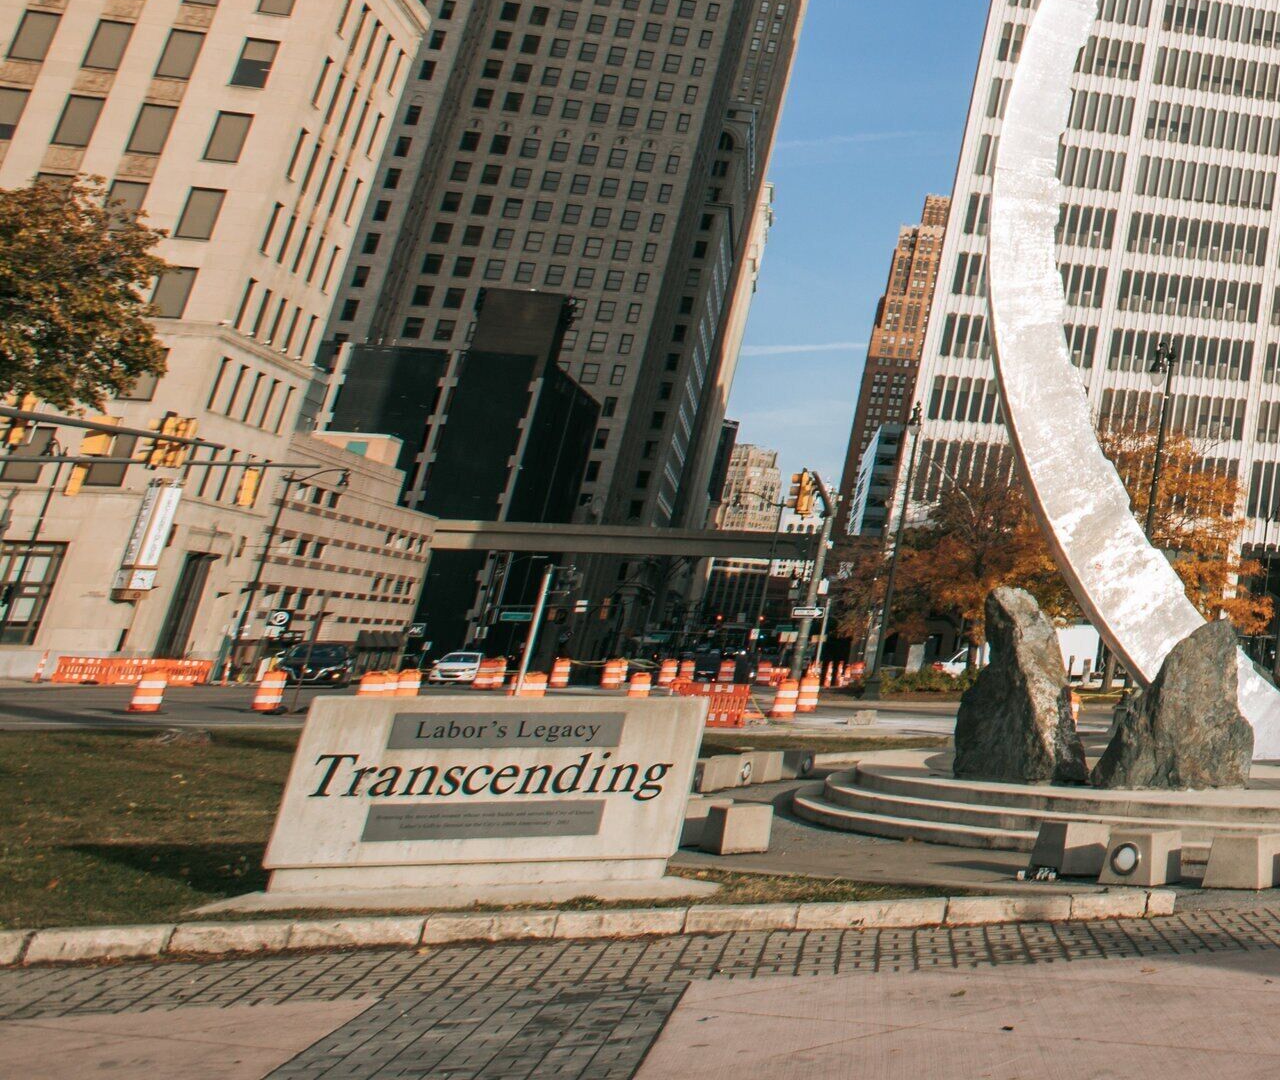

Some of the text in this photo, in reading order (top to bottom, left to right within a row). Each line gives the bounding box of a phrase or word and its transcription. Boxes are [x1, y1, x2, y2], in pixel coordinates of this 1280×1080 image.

[415, 719, 602, 742] Labor's Legacy
[307, 751, 675, 802] Transcending
